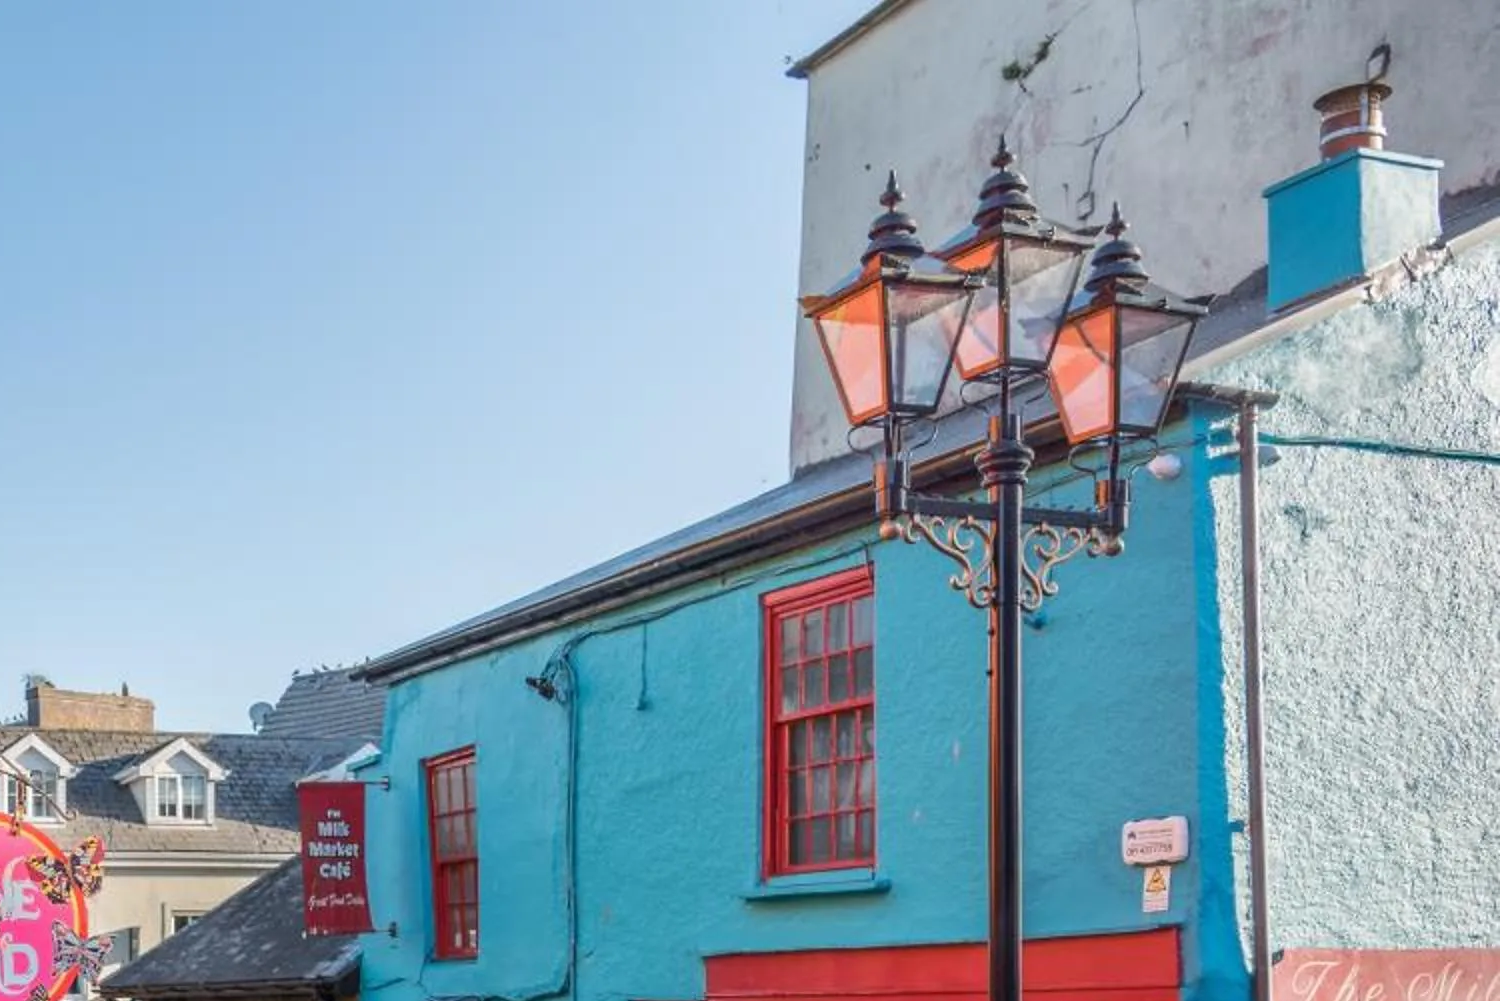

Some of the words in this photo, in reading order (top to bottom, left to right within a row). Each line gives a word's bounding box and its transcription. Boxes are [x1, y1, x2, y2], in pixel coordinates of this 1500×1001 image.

[317, 820, 350, 837] Milk
[308, 841, 360, 859] Market
[319, 861, 351, 880] Café
